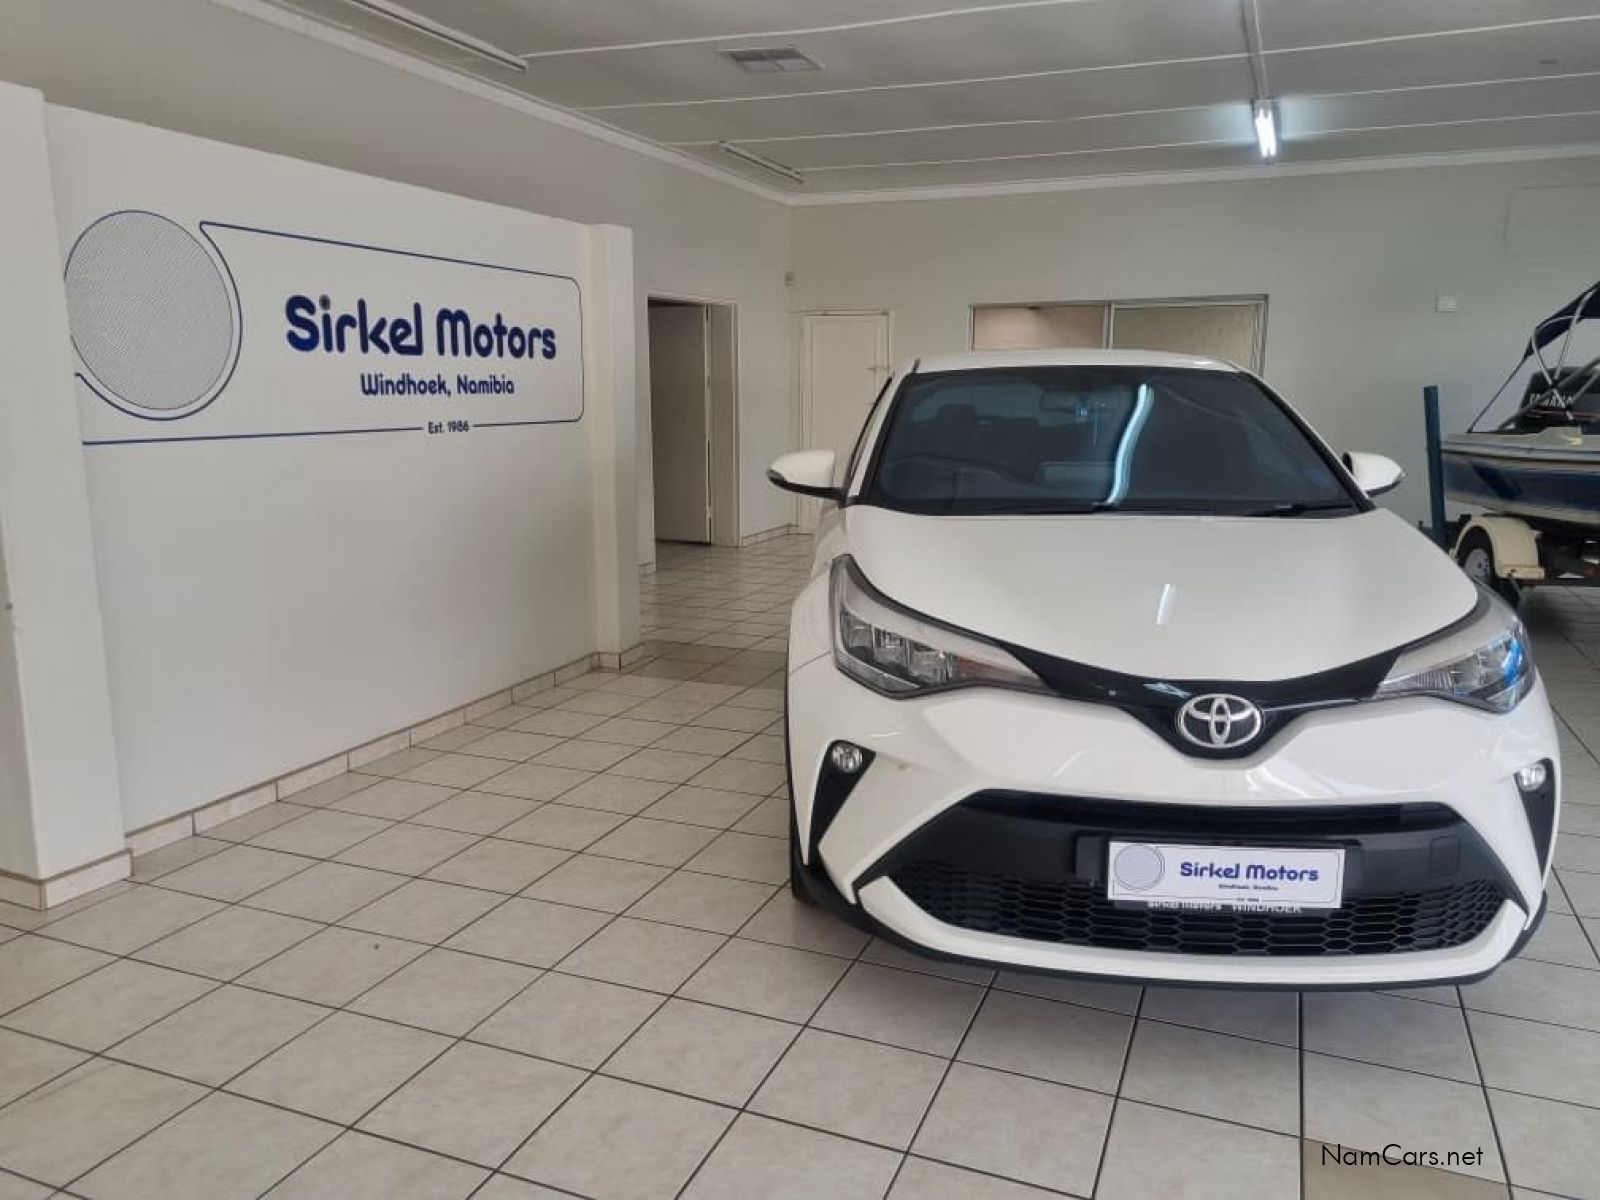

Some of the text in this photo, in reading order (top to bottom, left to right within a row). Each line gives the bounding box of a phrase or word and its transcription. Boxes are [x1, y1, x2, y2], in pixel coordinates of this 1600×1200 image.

[285, 294, 557, 359] Sirkel Motors
[360, 373, 515, 397] Windhoek, Namibia
[428, 421, 444, 434] Est.
[1180, 861, 1319, 881] Sirkel Motors
